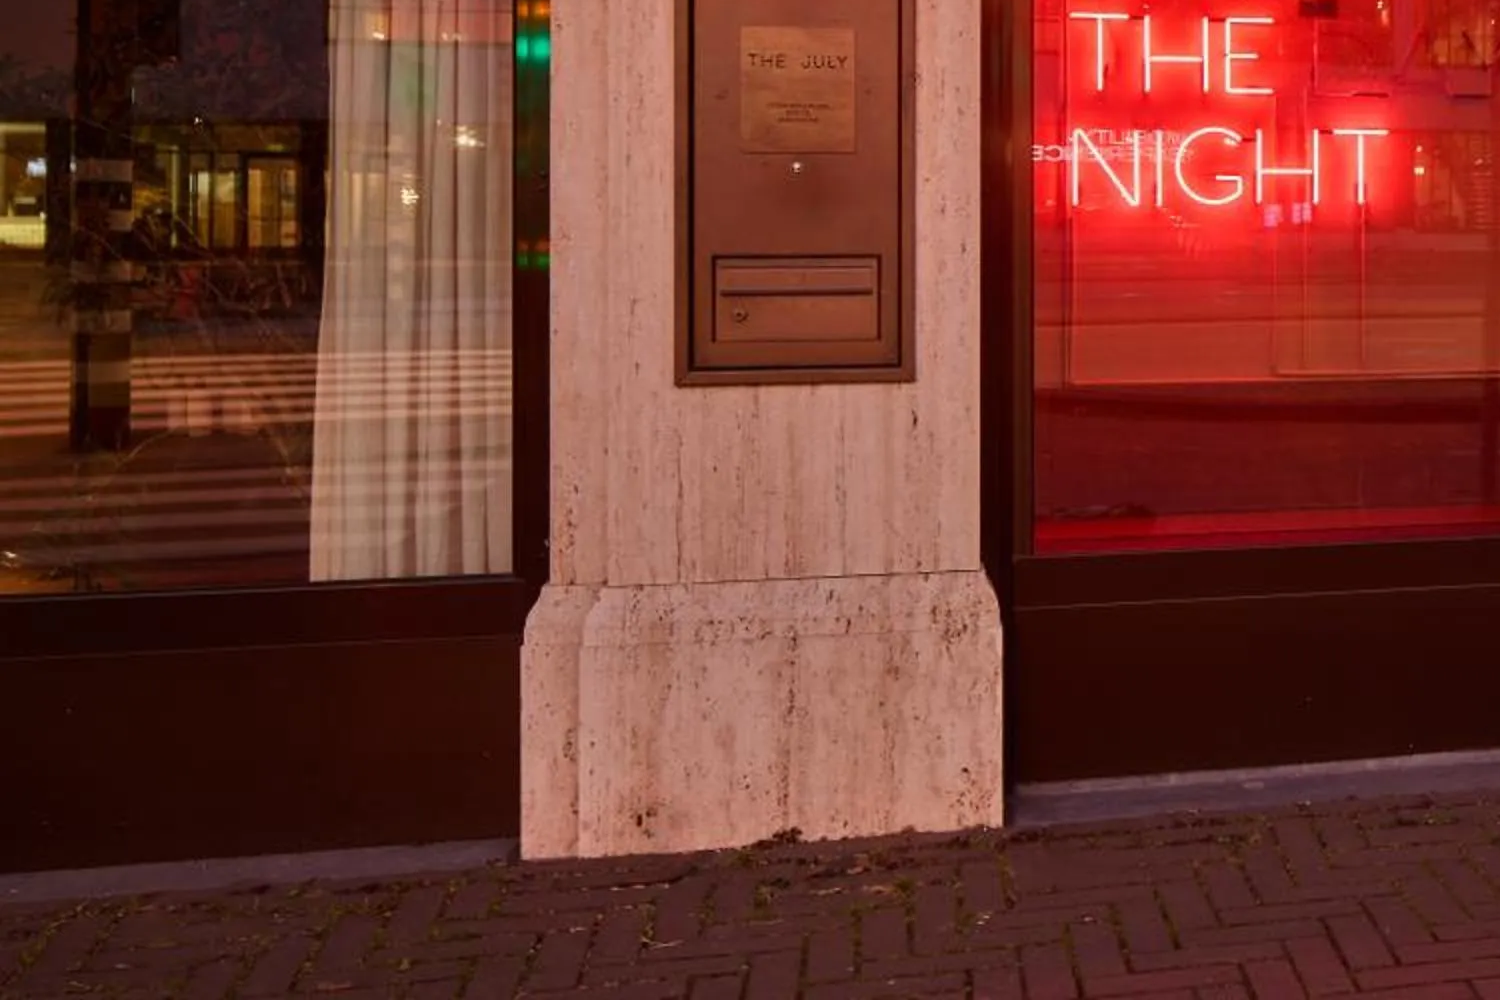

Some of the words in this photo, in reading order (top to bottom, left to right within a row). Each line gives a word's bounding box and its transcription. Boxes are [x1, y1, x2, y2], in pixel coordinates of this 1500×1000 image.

[747, 52, 786, 69] THE
[800, 54, 849, 70] JULY
[1068, 11, 1275, 94] THE
[1071, 126, 1391, 208] NIGHT
